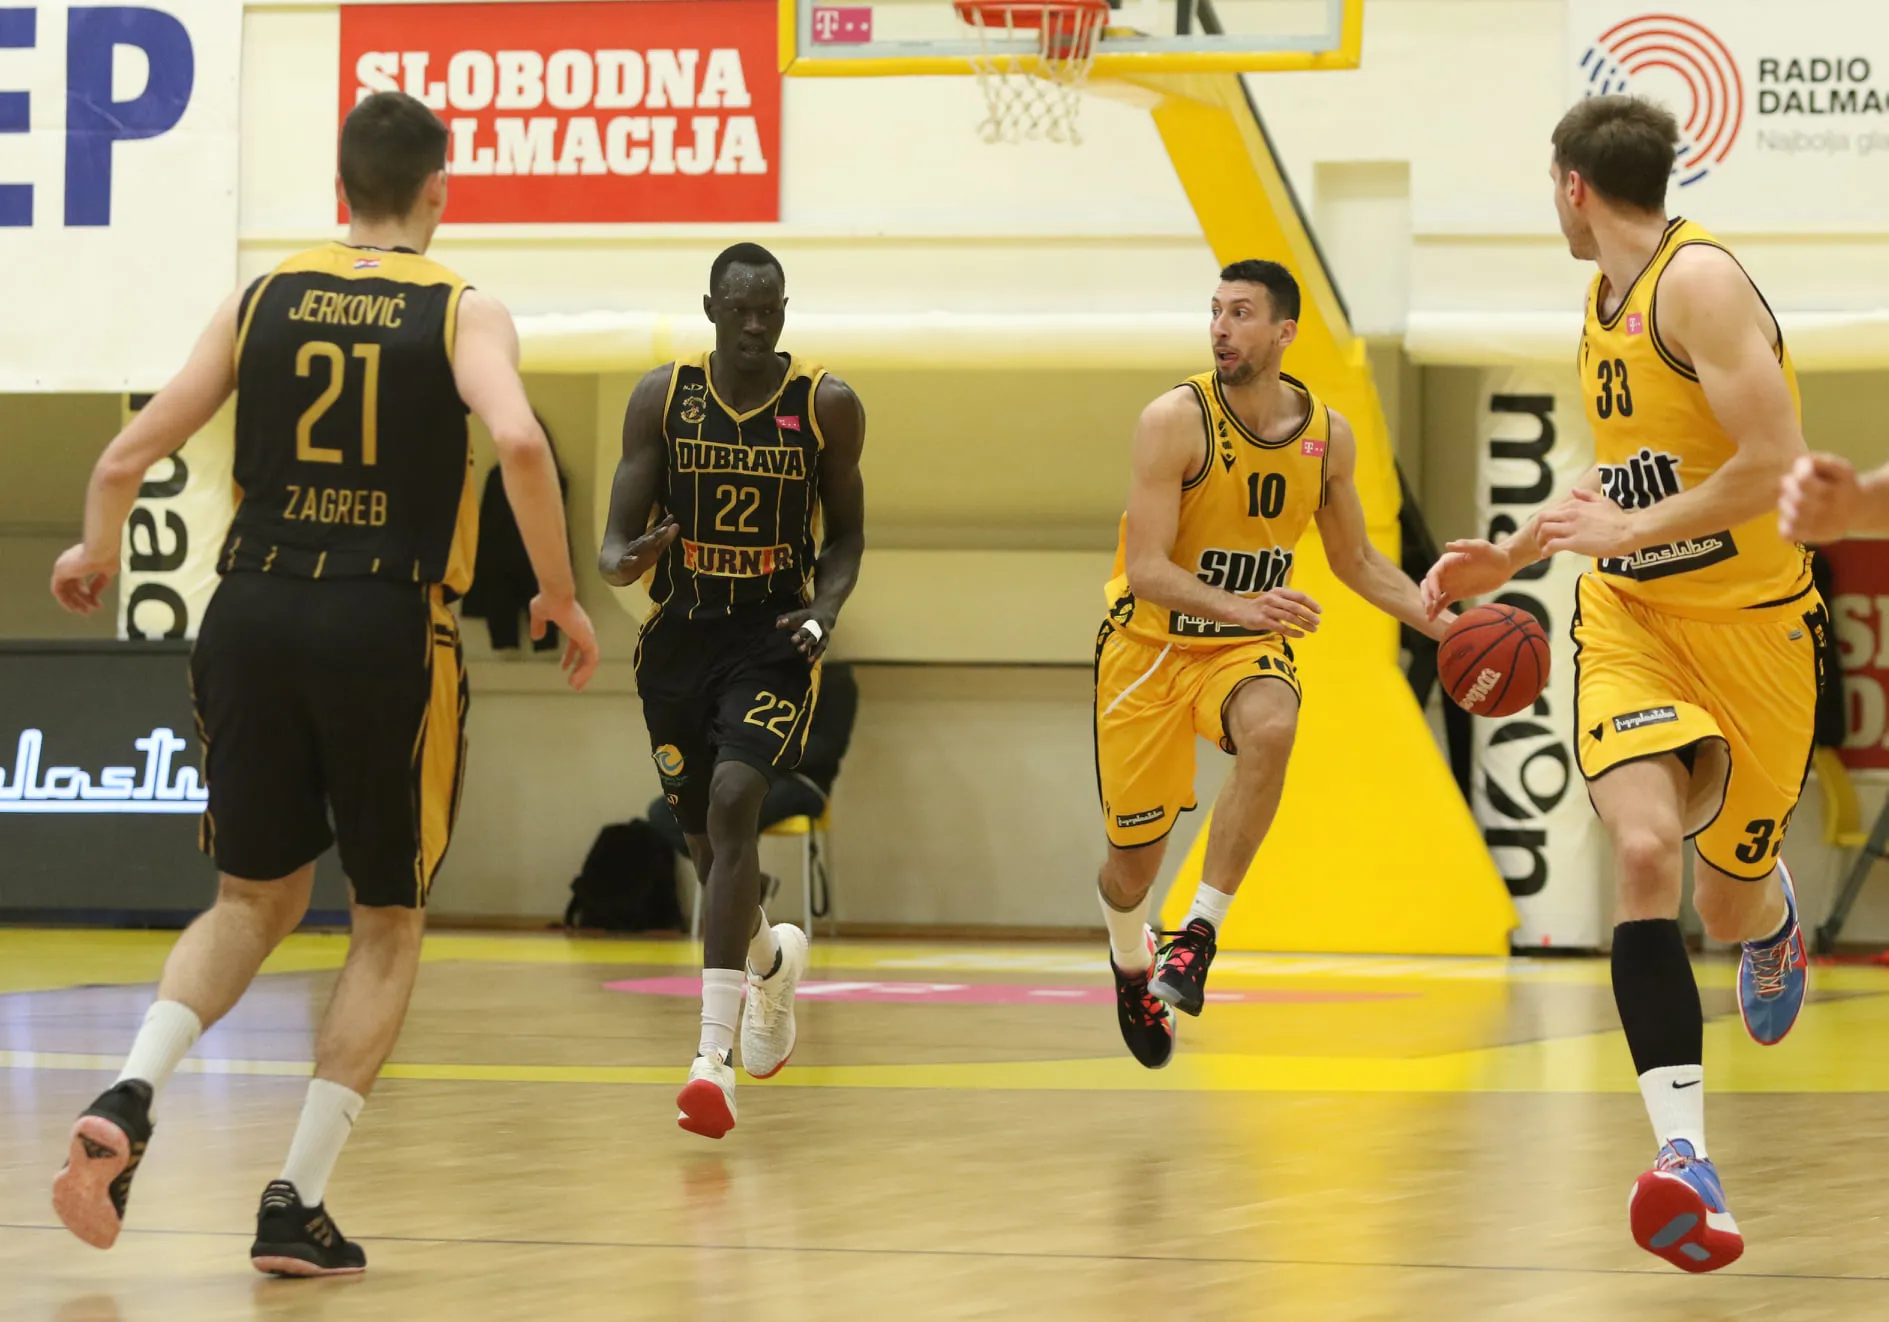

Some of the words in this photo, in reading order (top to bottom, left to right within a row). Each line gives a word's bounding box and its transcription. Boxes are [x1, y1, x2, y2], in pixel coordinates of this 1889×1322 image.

[356, 48, 752, 110] SLOBODNA
[1759, 57, 1871, 83] RADIO
[1759, 89, 1889, 115] DALMA
[446, 115, 768, 177] LMACIJA
[288, 289, 406, 329] JERKOVIĆ
[295, 340, 381, 466] 21
[1596, 358, 1633, 420] 33
[677, 442, 804, 479] DUBRAVA
[283, 485, 388, 526] ZAGREB
[715, 484, 761, 533] 22
[1247, 472, 1286, 519] 10
[685, 541, 793, 575] FURNIR
[1197, 547, 1293, 593] split
[743, 690, 797, 739] 22
